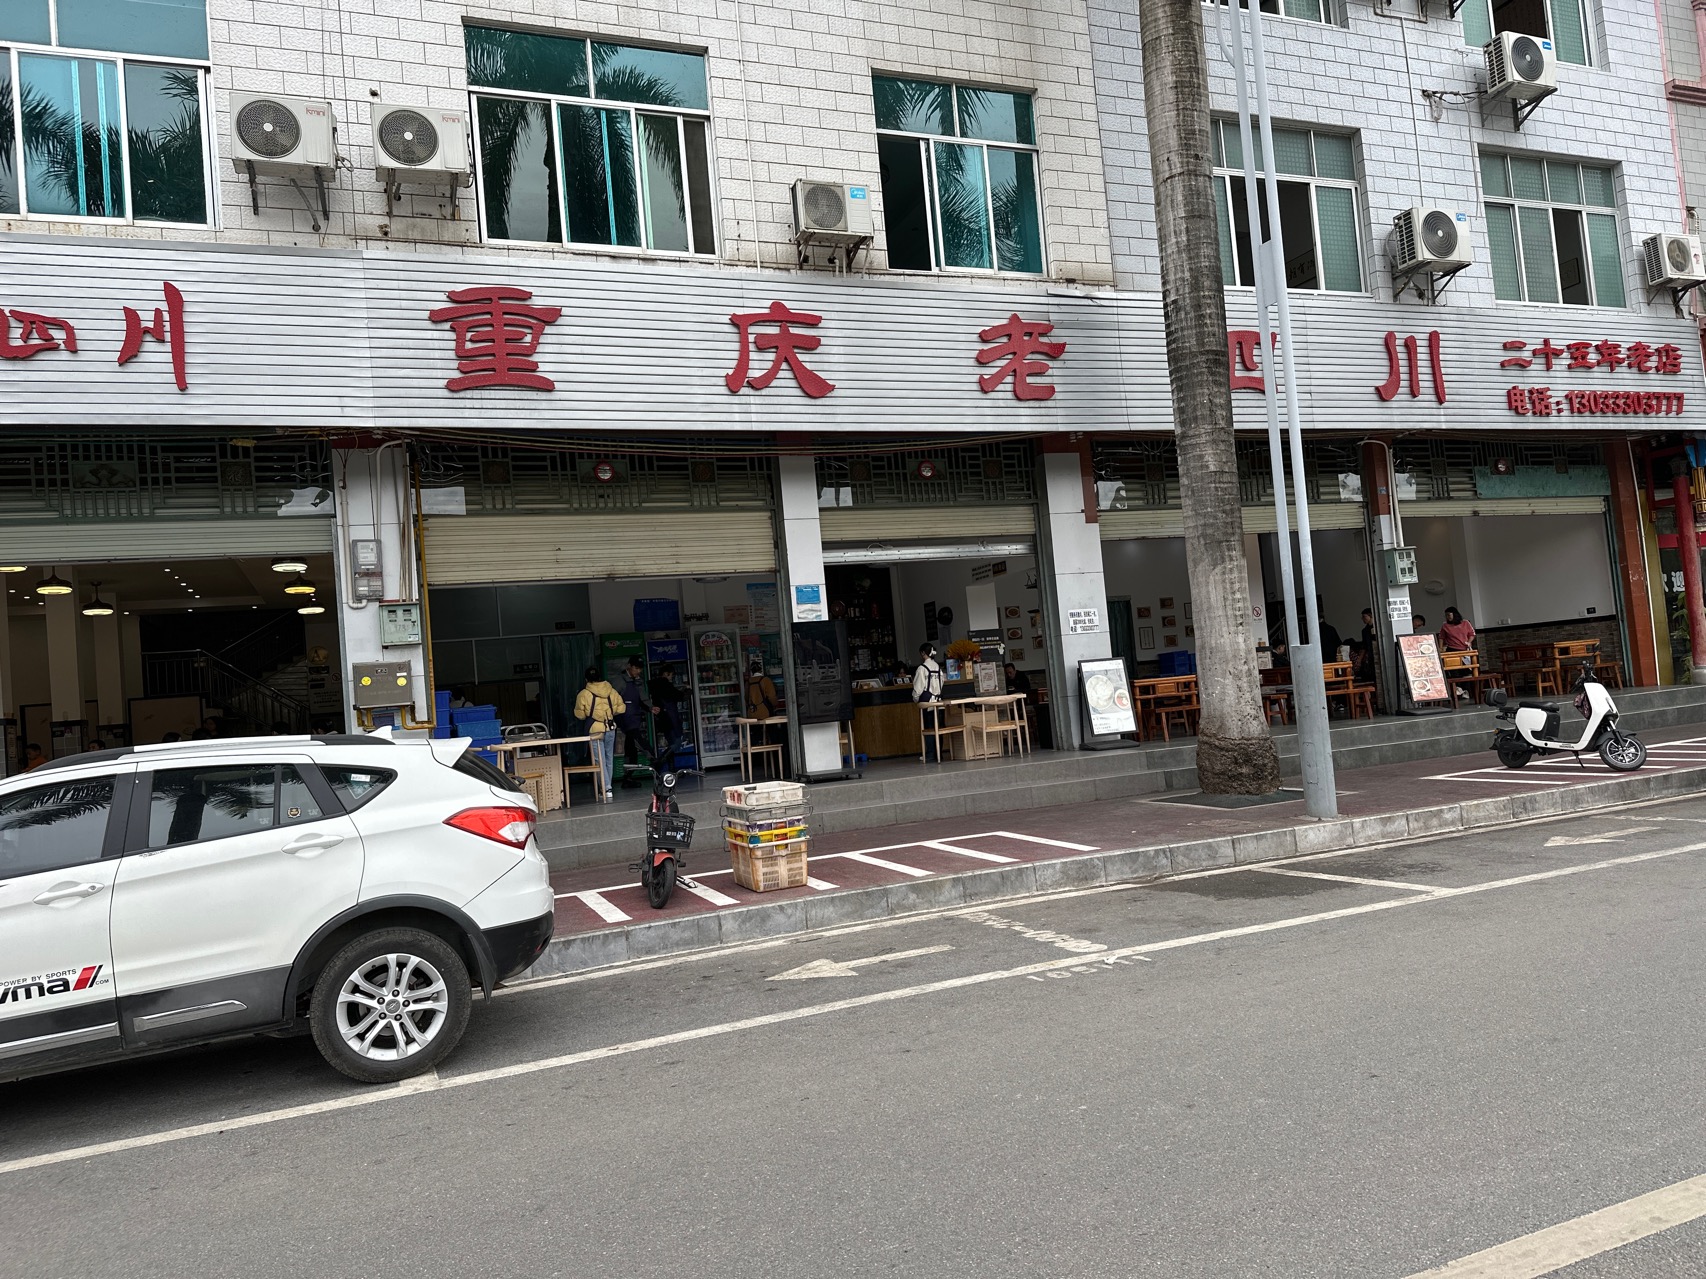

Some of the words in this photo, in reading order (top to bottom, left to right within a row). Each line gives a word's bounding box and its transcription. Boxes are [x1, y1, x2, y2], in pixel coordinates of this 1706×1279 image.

[1499, 338, 1683, 373] 二十五年老店
[0, 977, 28, 987] POWER
[31, 975, 42, 983] BY
[45, 968, 77, 980] SPORTS
